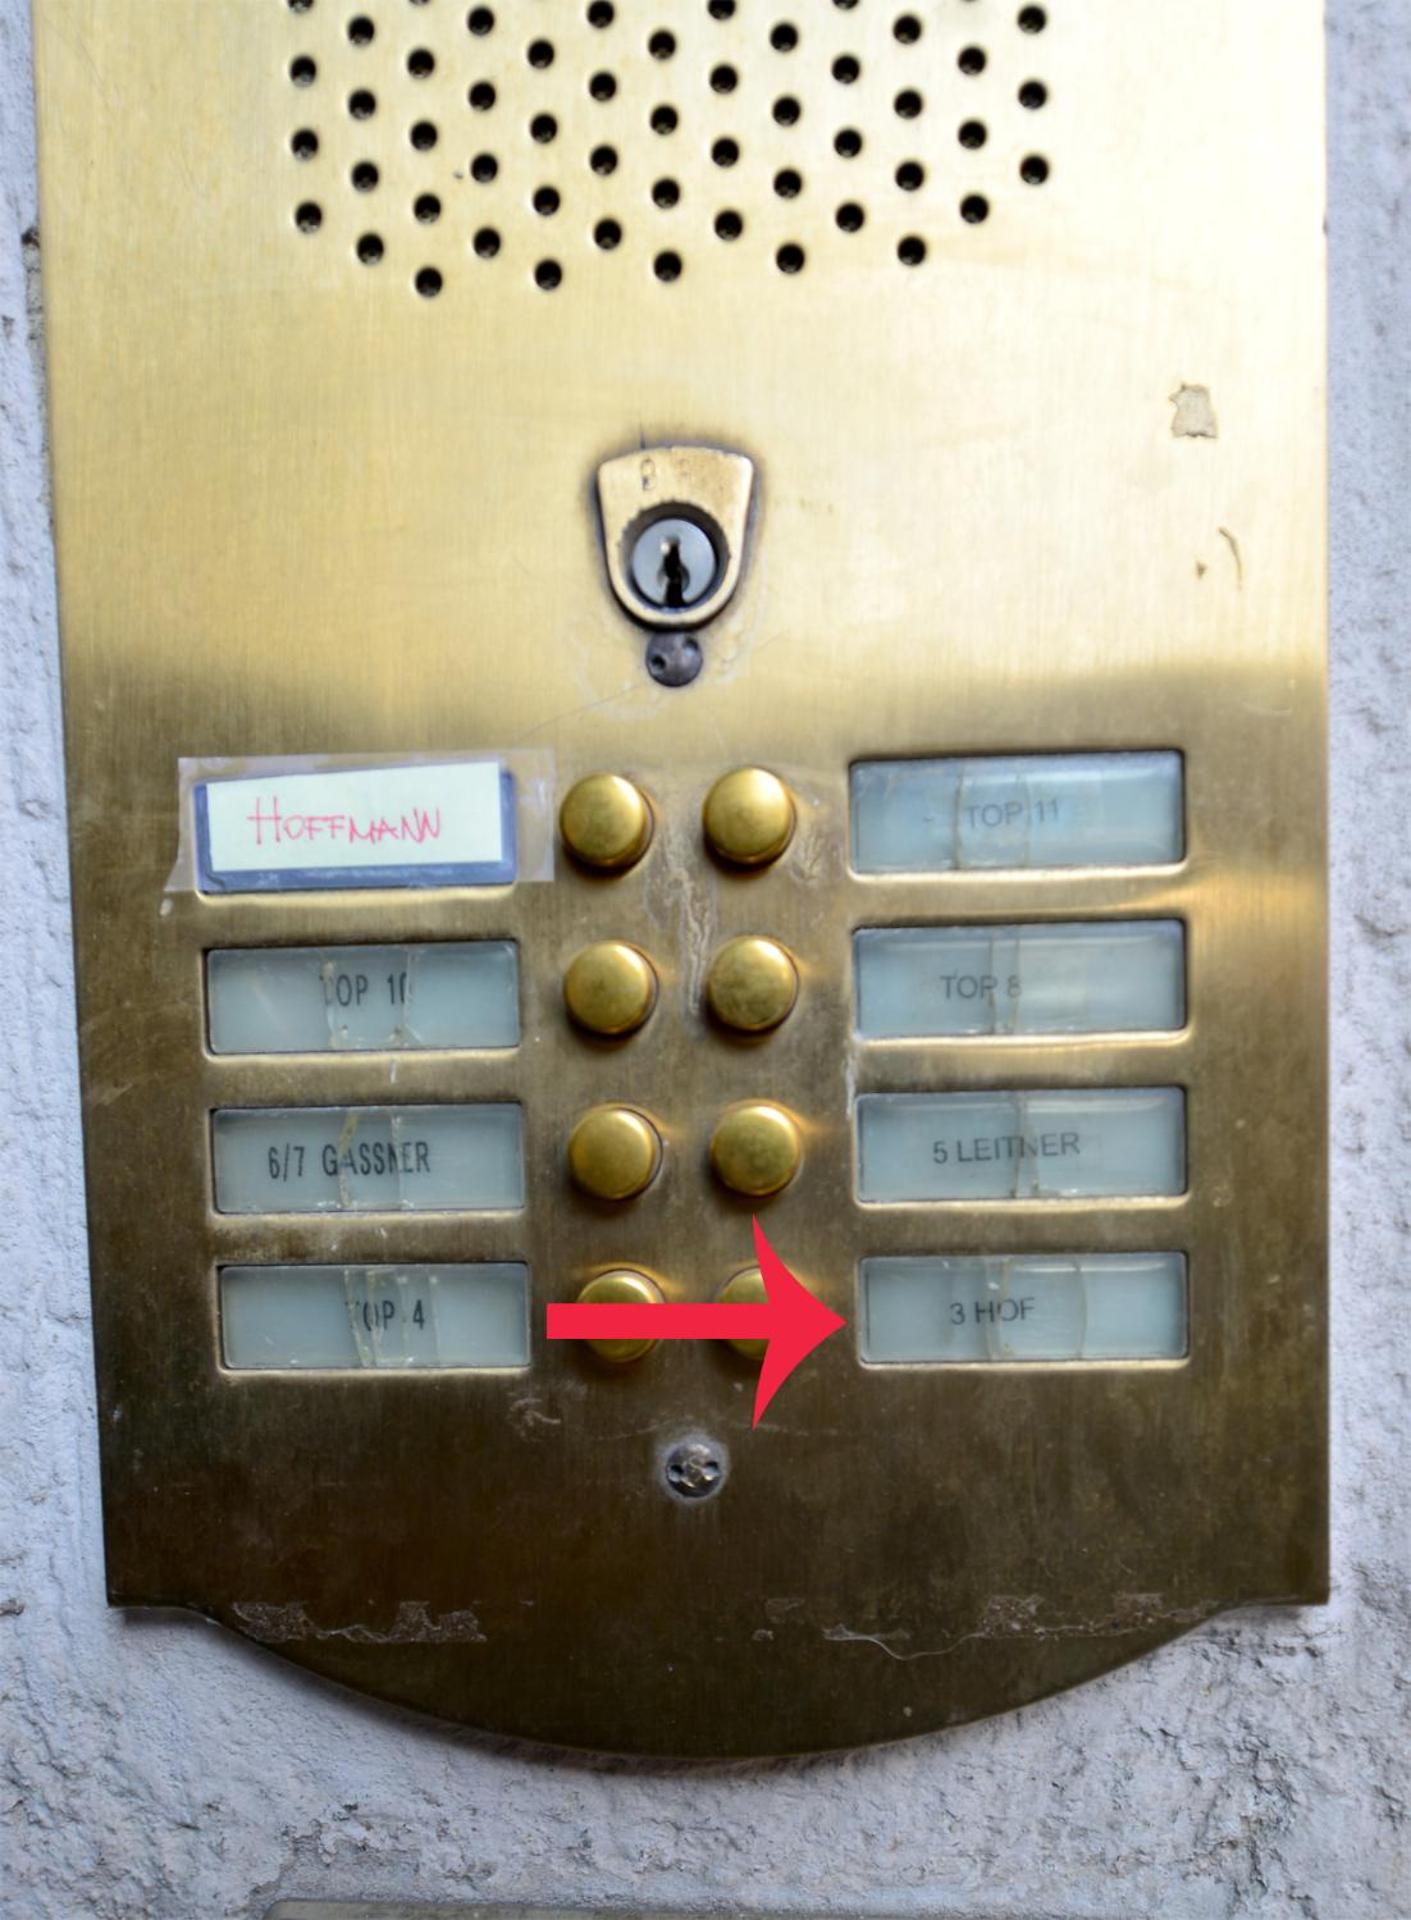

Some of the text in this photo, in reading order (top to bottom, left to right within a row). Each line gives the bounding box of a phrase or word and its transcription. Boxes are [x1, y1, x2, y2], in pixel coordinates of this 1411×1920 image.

[247, 796, 442, 845] HOFFMANN
[964, 799, 1060, 828] TOP 11
[319, 973, 369, 1007] OP
[940, 973, 998, 999] TOP
[267, 1141, 431, 1182] 6/7 GASSNER
[932, 1131, 1081, 1164] 5 LEITNER
[344, 1299, 425, 1332] OP 4
[950, 1297, 1036, 1325] 3 HOF
